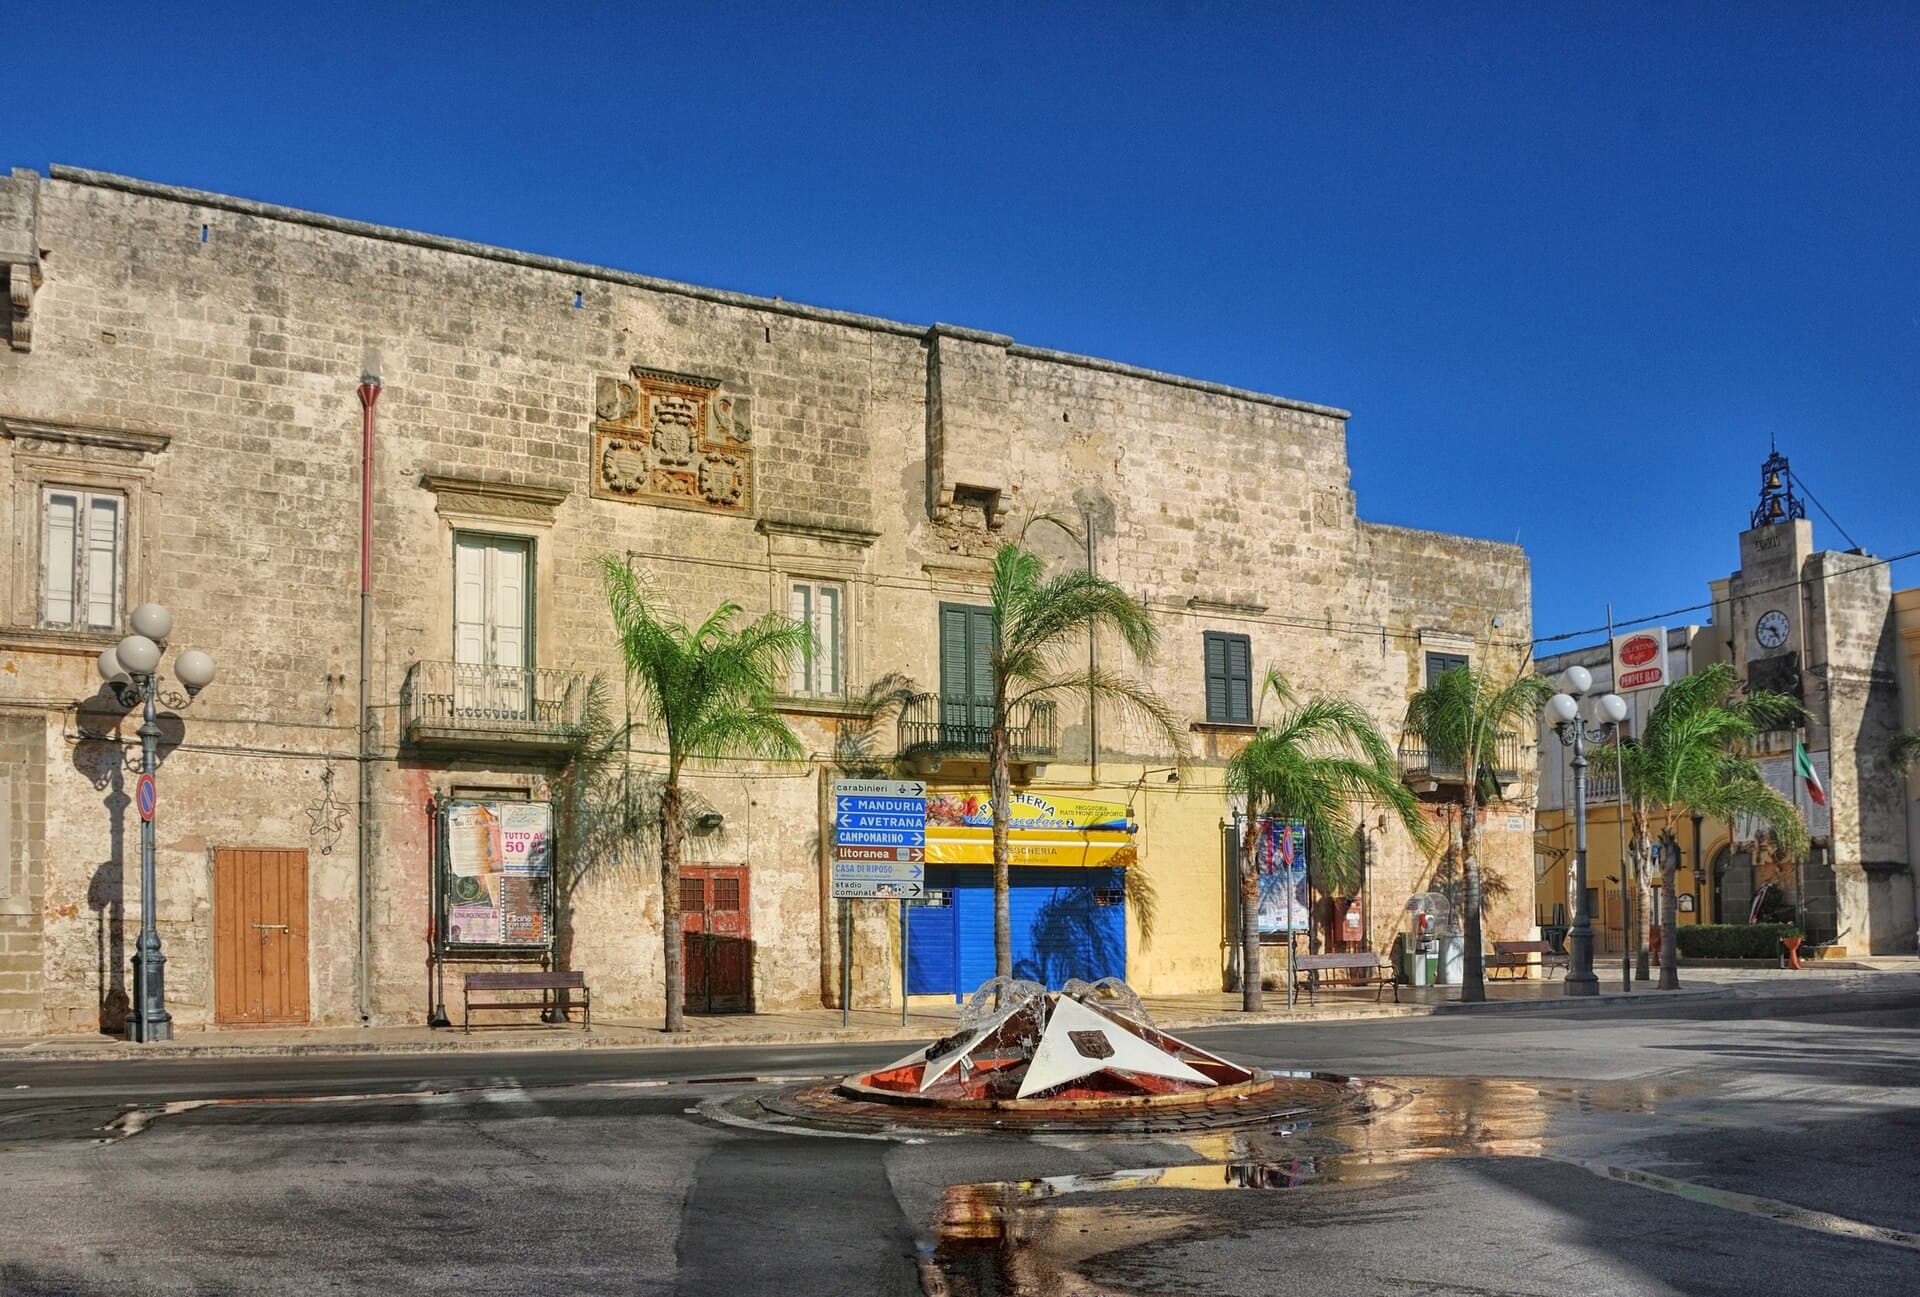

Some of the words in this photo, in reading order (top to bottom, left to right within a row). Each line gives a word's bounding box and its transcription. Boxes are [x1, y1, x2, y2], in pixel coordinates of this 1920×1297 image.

[836, 784, 888, 793] carabinieri
[858, 800, 923, 812] MANDURIA
[980, 793, 1055, 816] PECHERIA
[859, 816, 923, 828] AVETRANA
[504, 831, 531, 840] TUTTO
[840, 832, 904, 843] CAMPOMARINO
[505, 841, 525, 853] 50
[1008, 847, 1057, 855] ESCHERIA
[840, 848, 889, 859] litoranea
[835, 864, 855, 873] CASA
[857, 864, 865, 872] DI
[866, 864, 893, 873] RIPOSO
